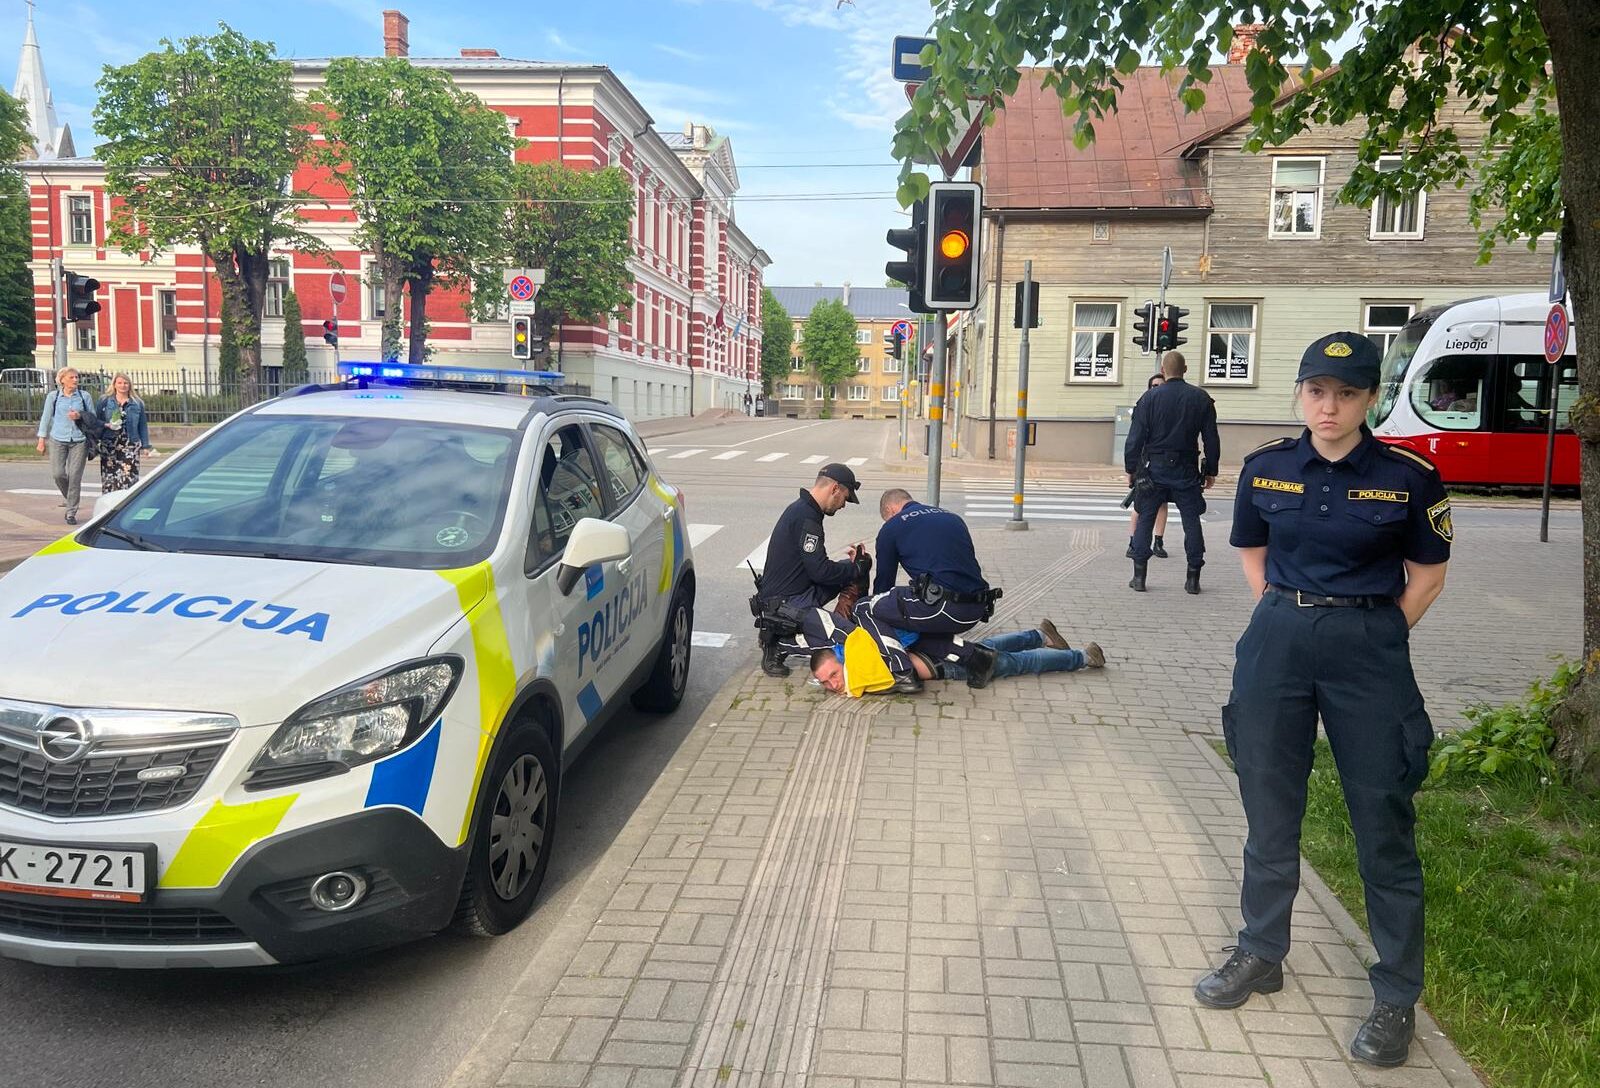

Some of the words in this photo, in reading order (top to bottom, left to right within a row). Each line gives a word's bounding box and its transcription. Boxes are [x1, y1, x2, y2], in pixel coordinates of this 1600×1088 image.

[1445, 338, 1488, 351] Liepāja
[1359, 491, 1397, 500] POLICIJA
[901, 508, 947, 520] POLICI
[10, 590, 331, 643] POLICIJA
[577, 568, 647, 679] POLICIJA
